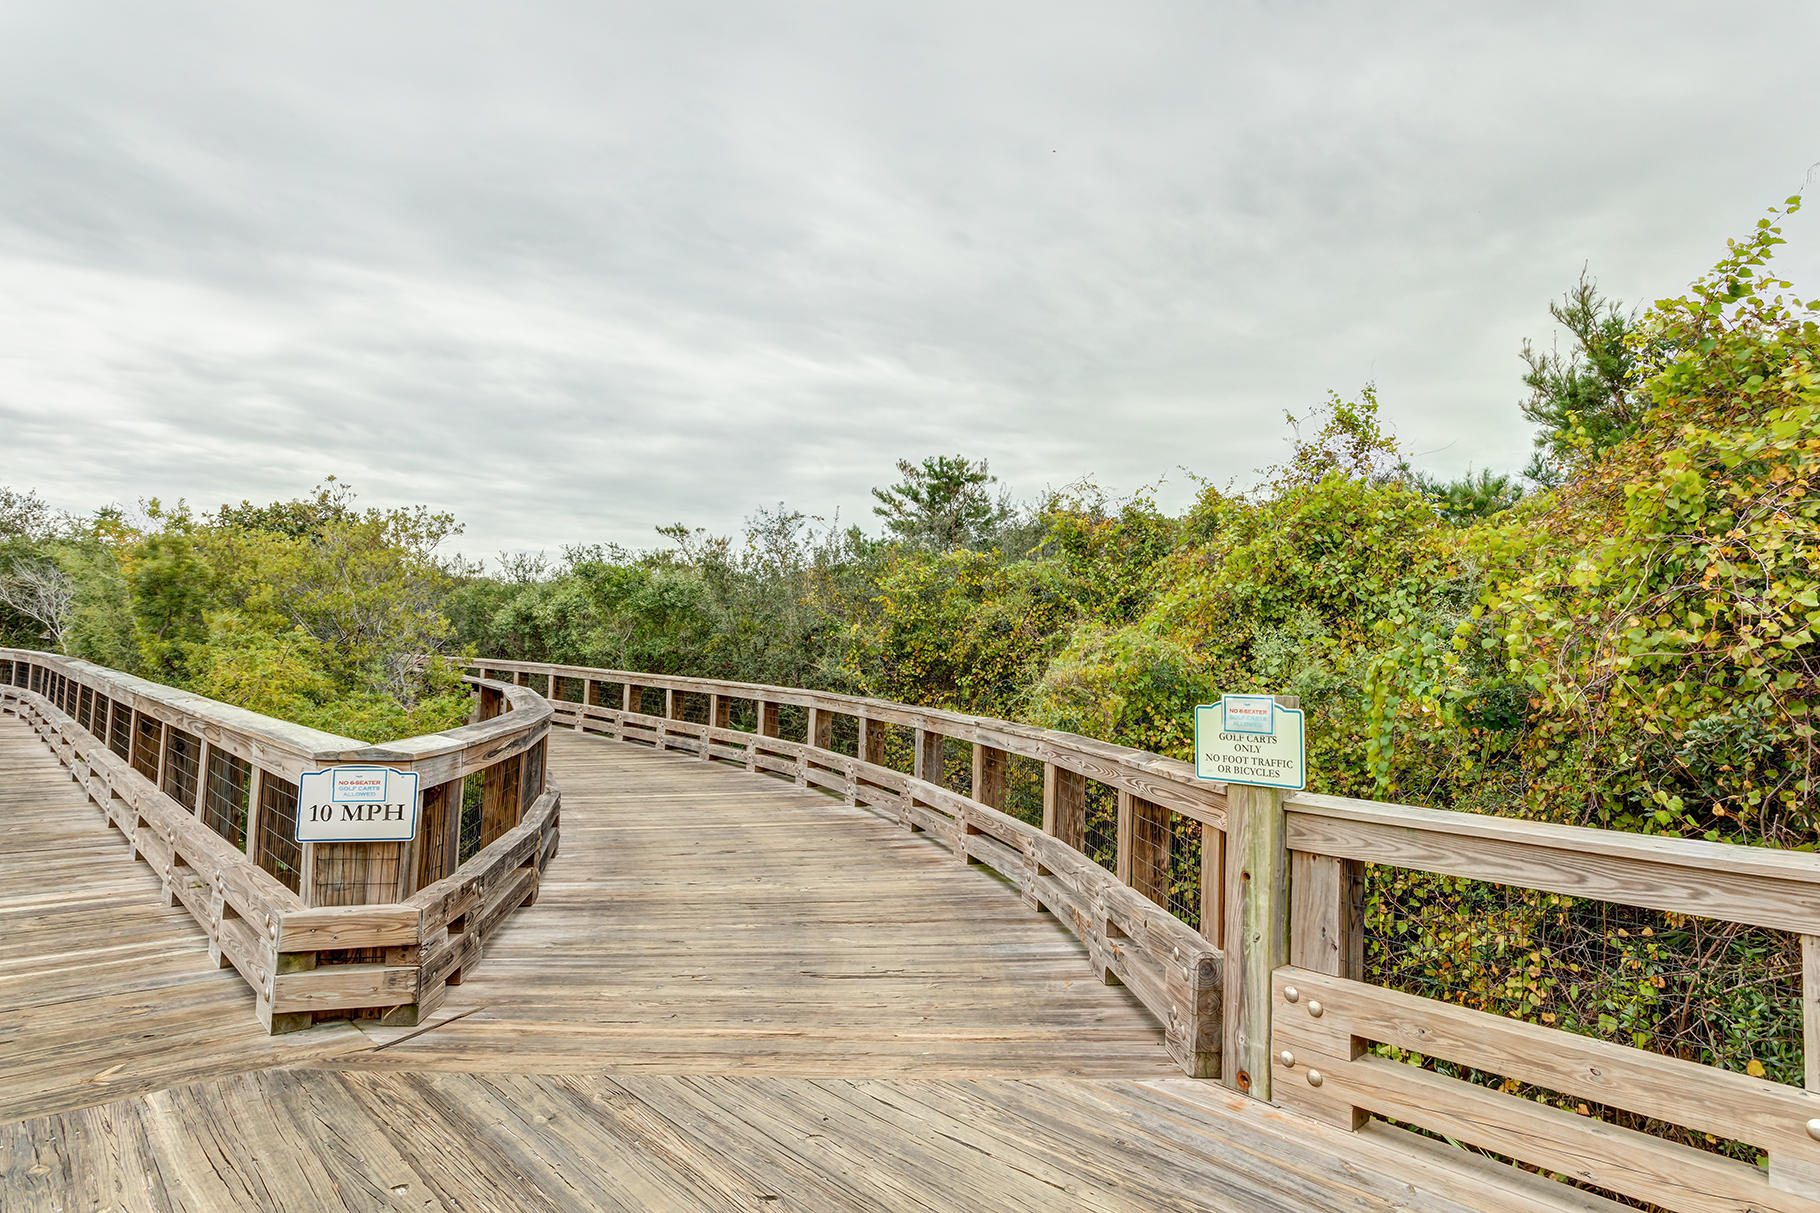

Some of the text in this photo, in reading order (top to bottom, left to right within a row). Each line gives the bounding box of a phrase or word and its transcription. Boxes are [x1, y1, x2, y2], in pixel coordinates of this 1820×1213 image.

[1218, 732, 1278, 744] GOLF CARTS
[1234, 743, 1262, 754] ONLY
[1205, 753, 1294, 769] NO FOOT TRAFFIC
[1217, 764, 1281, 778] OR BICYCLES
[309, 804, 406, 822] 10 MPH
